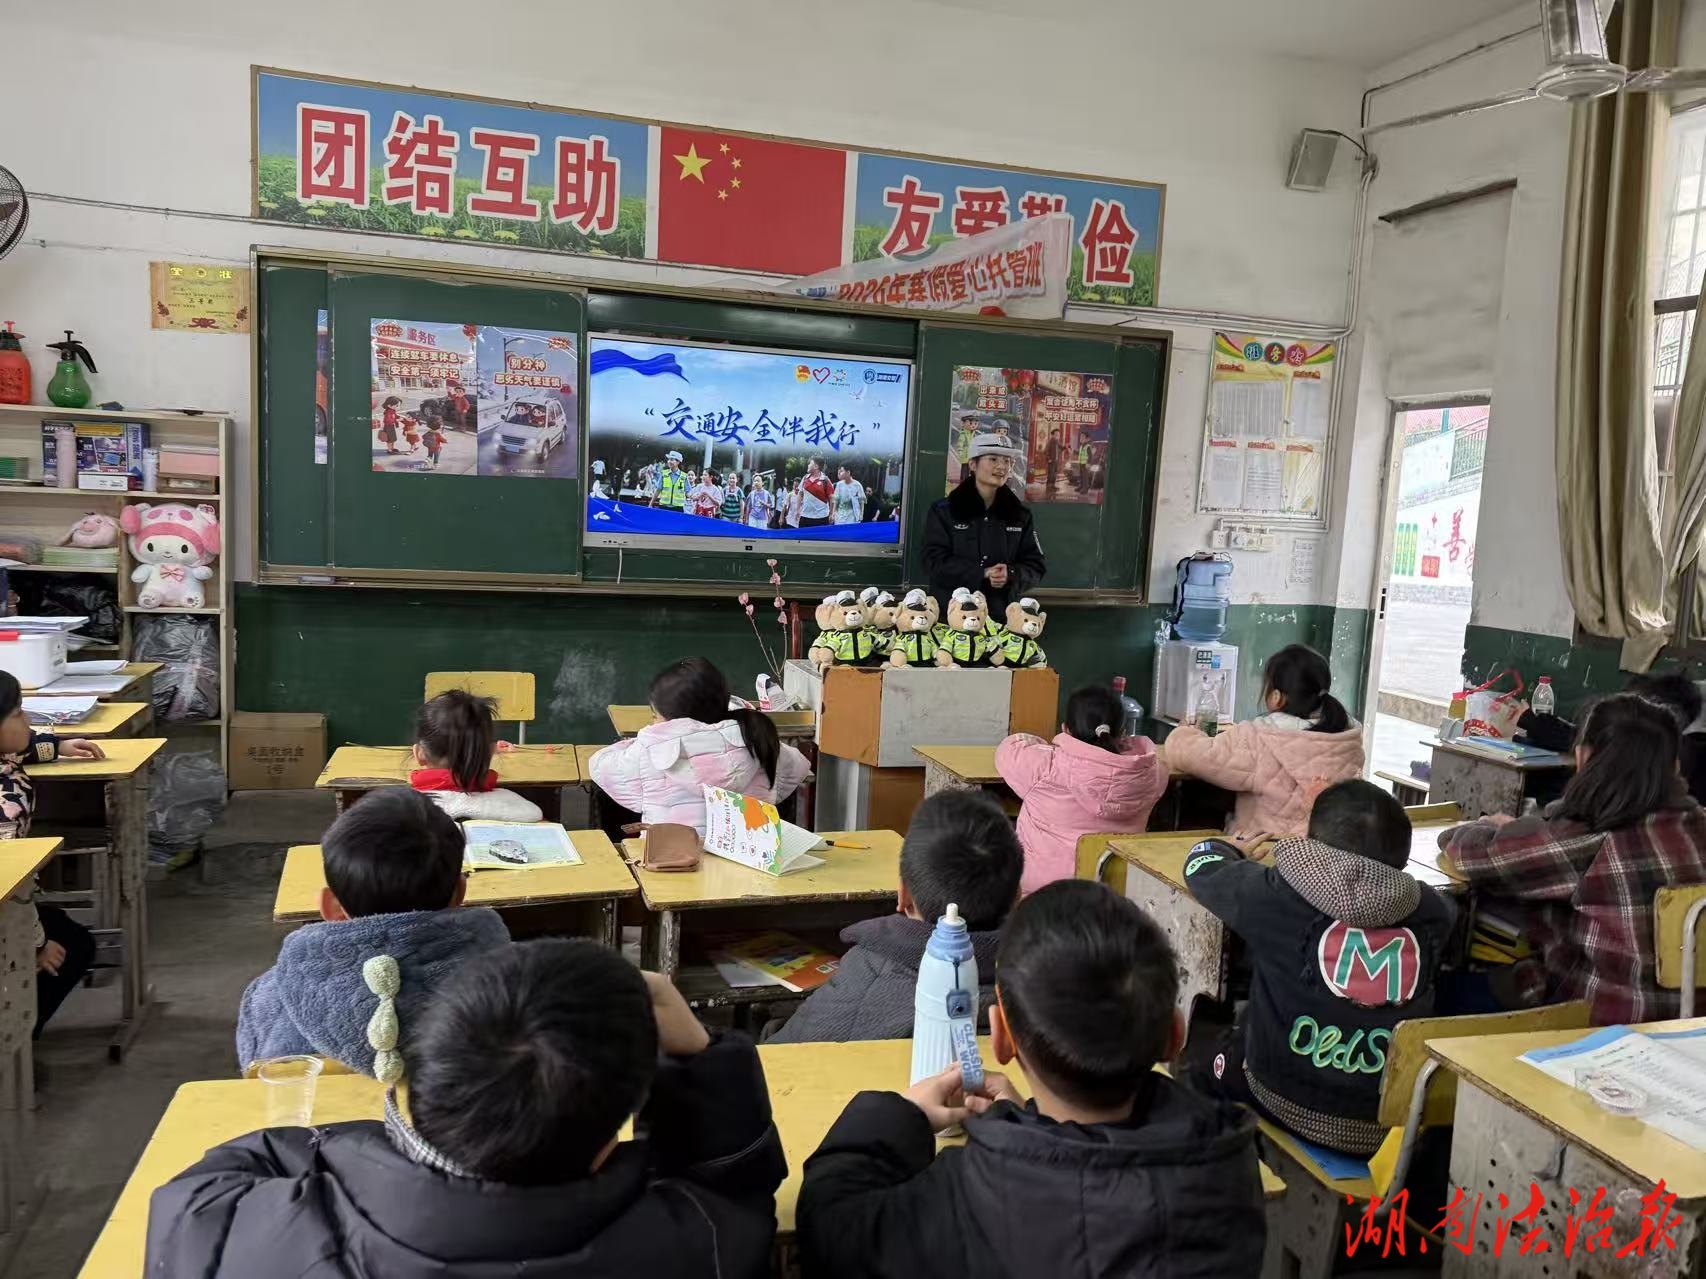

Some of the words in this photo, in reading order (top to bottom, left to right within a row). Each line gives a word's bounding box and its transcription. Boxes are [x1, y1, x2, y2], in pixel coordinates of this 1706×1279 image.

[300, 105, 619, 233] 团结互助
[389, 364, 460, 380] 安全第一须牢记
[510, 357, 547, 372] 别分神
[1333, 927, 1406, 1004] M
[963, 1022, 984, 1080] CLASSIC
